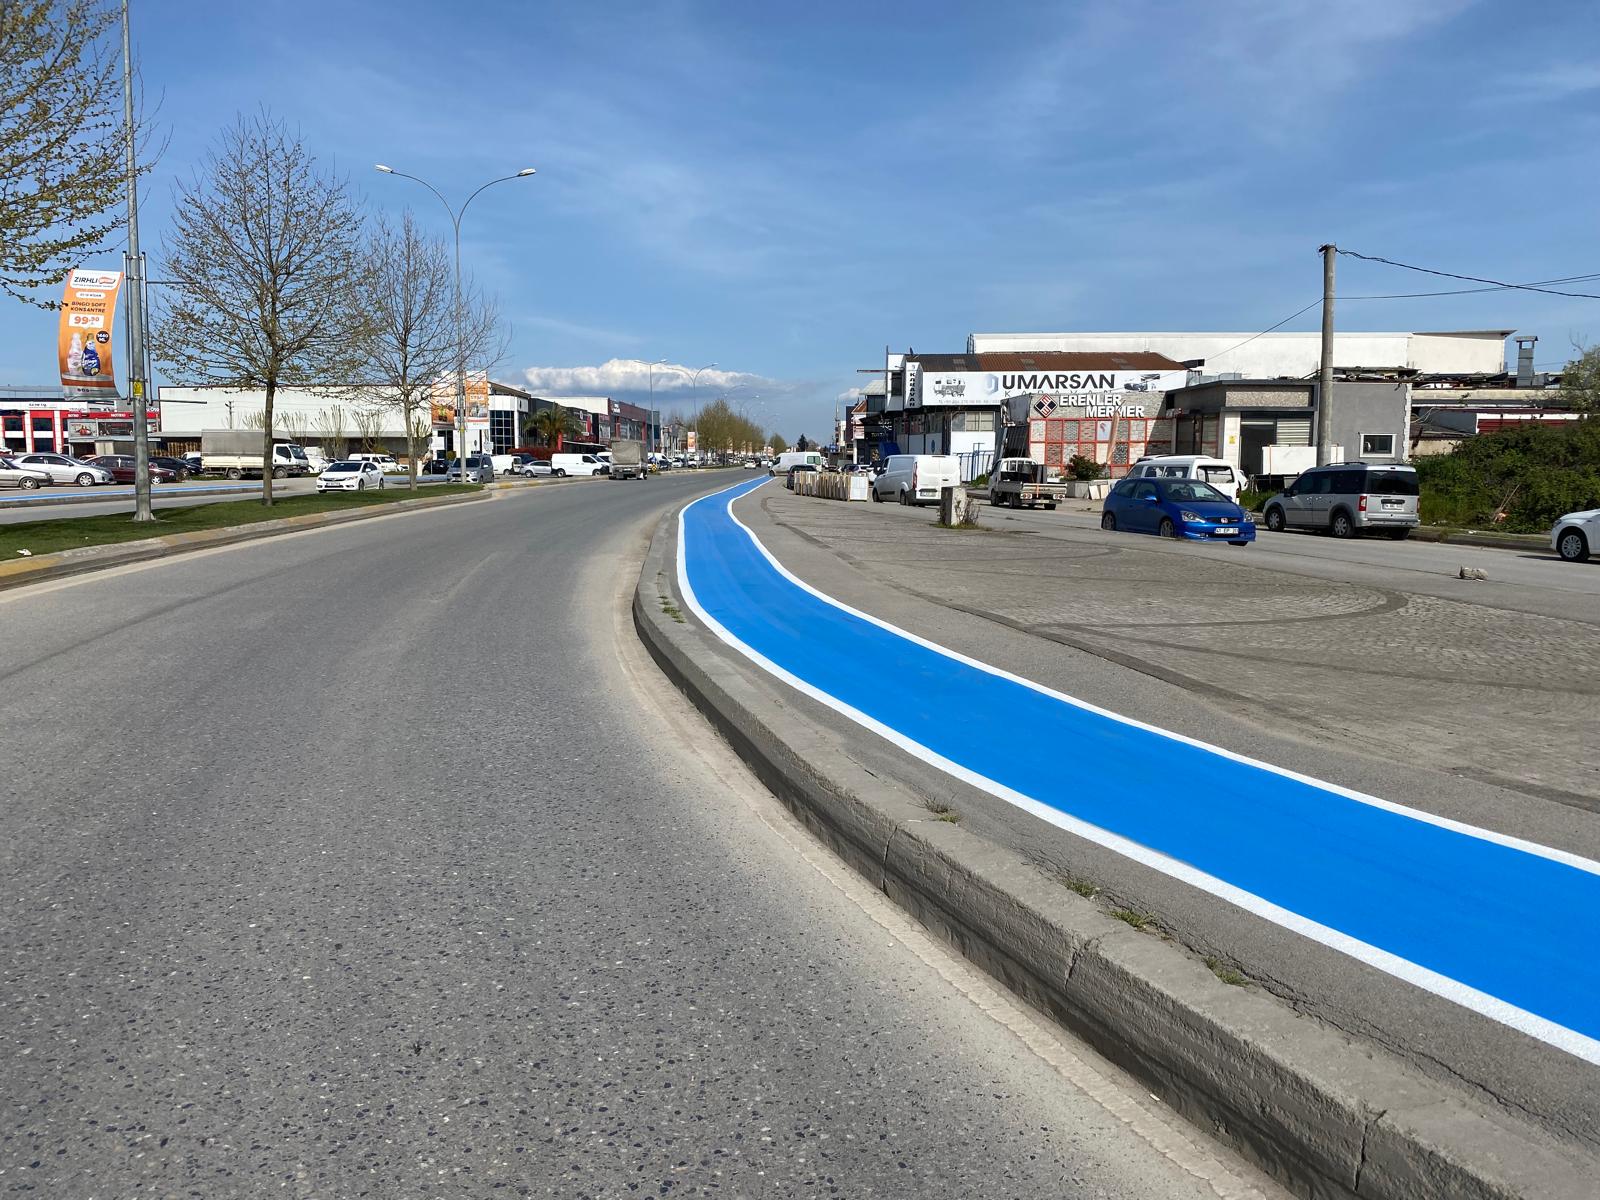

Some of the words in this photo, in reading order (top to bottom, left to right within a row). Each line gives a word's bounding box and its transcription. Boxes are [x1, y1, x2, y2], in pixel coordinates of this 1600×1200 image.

[1002, 373, 1116, 390] UMARSAN
[1059, 394, 1123, 407] ERENLER
[1085, 405, 1145, 418] MERMER
